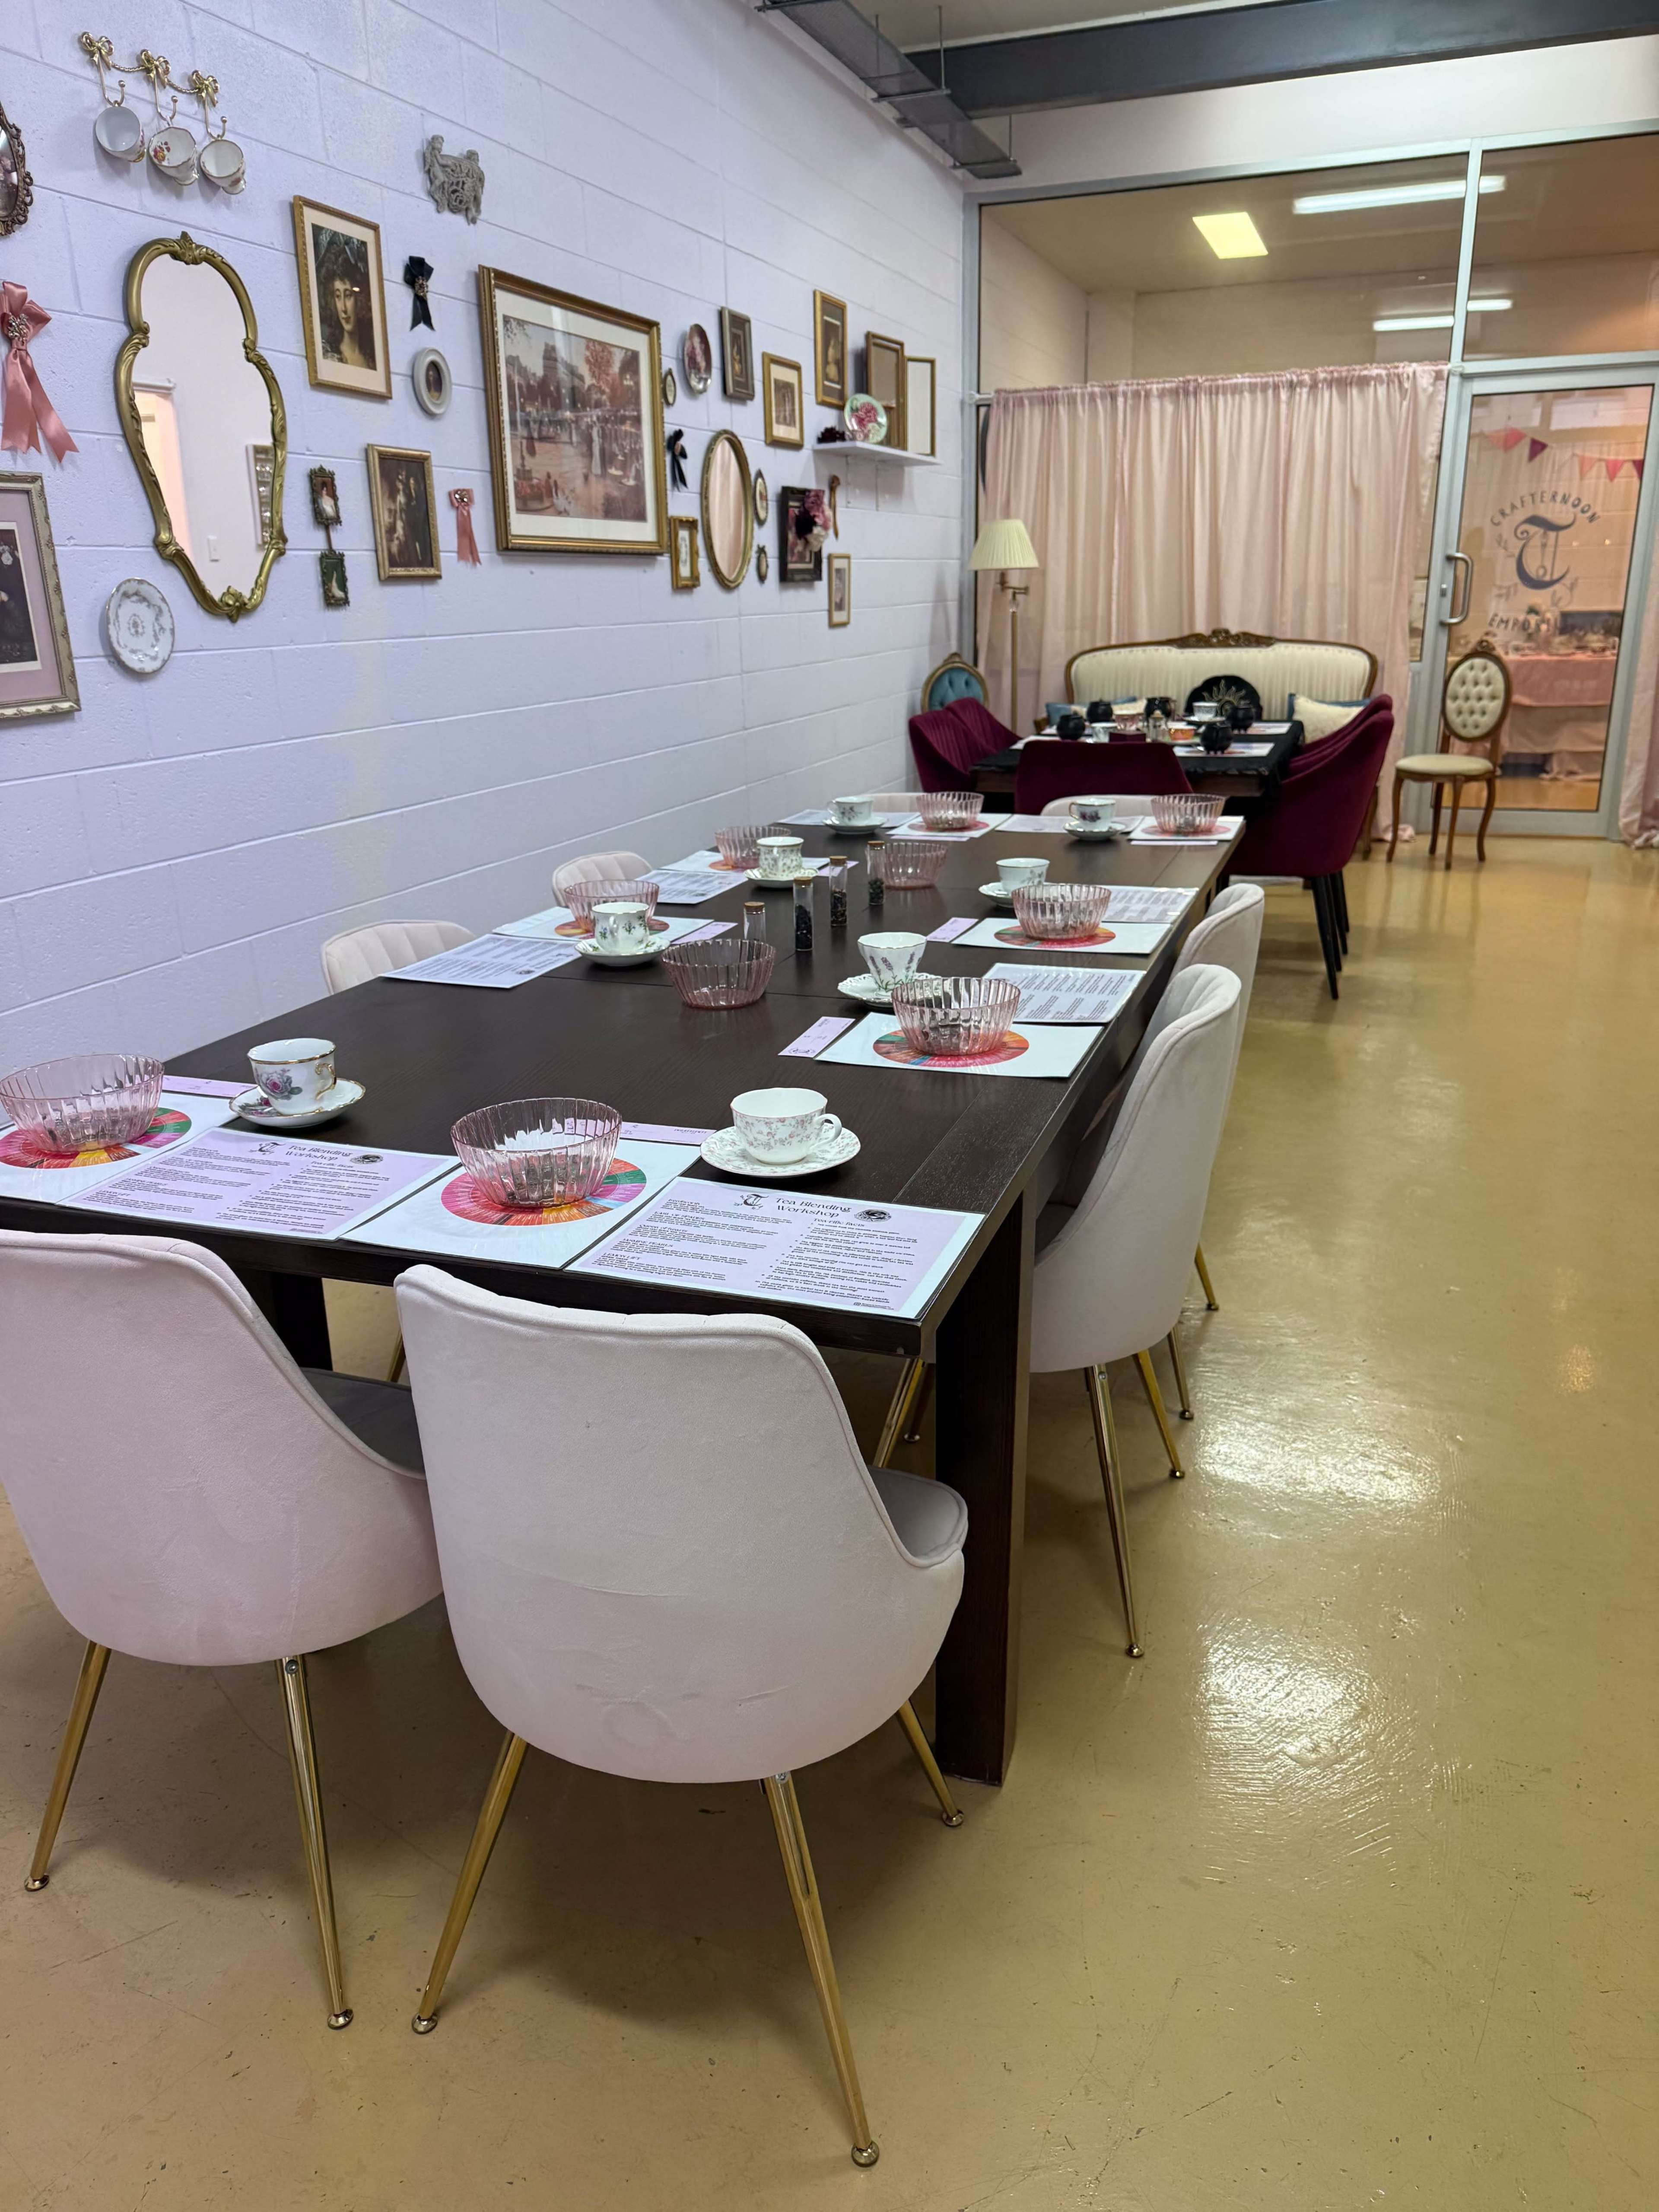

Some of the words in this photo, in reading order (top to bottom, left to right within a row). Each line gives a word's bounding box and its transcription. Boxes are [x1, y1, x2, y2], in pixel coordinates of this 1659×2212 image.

[1490, 490, 1600, 526] CRAFTERNOON
[285, 1151, 338, 1161] Workshop
[308, 1147, 354, 1157] Blending
[777, 1205, 840, 1218] Workshop
[800, 1201, 852, 1213] Blending
